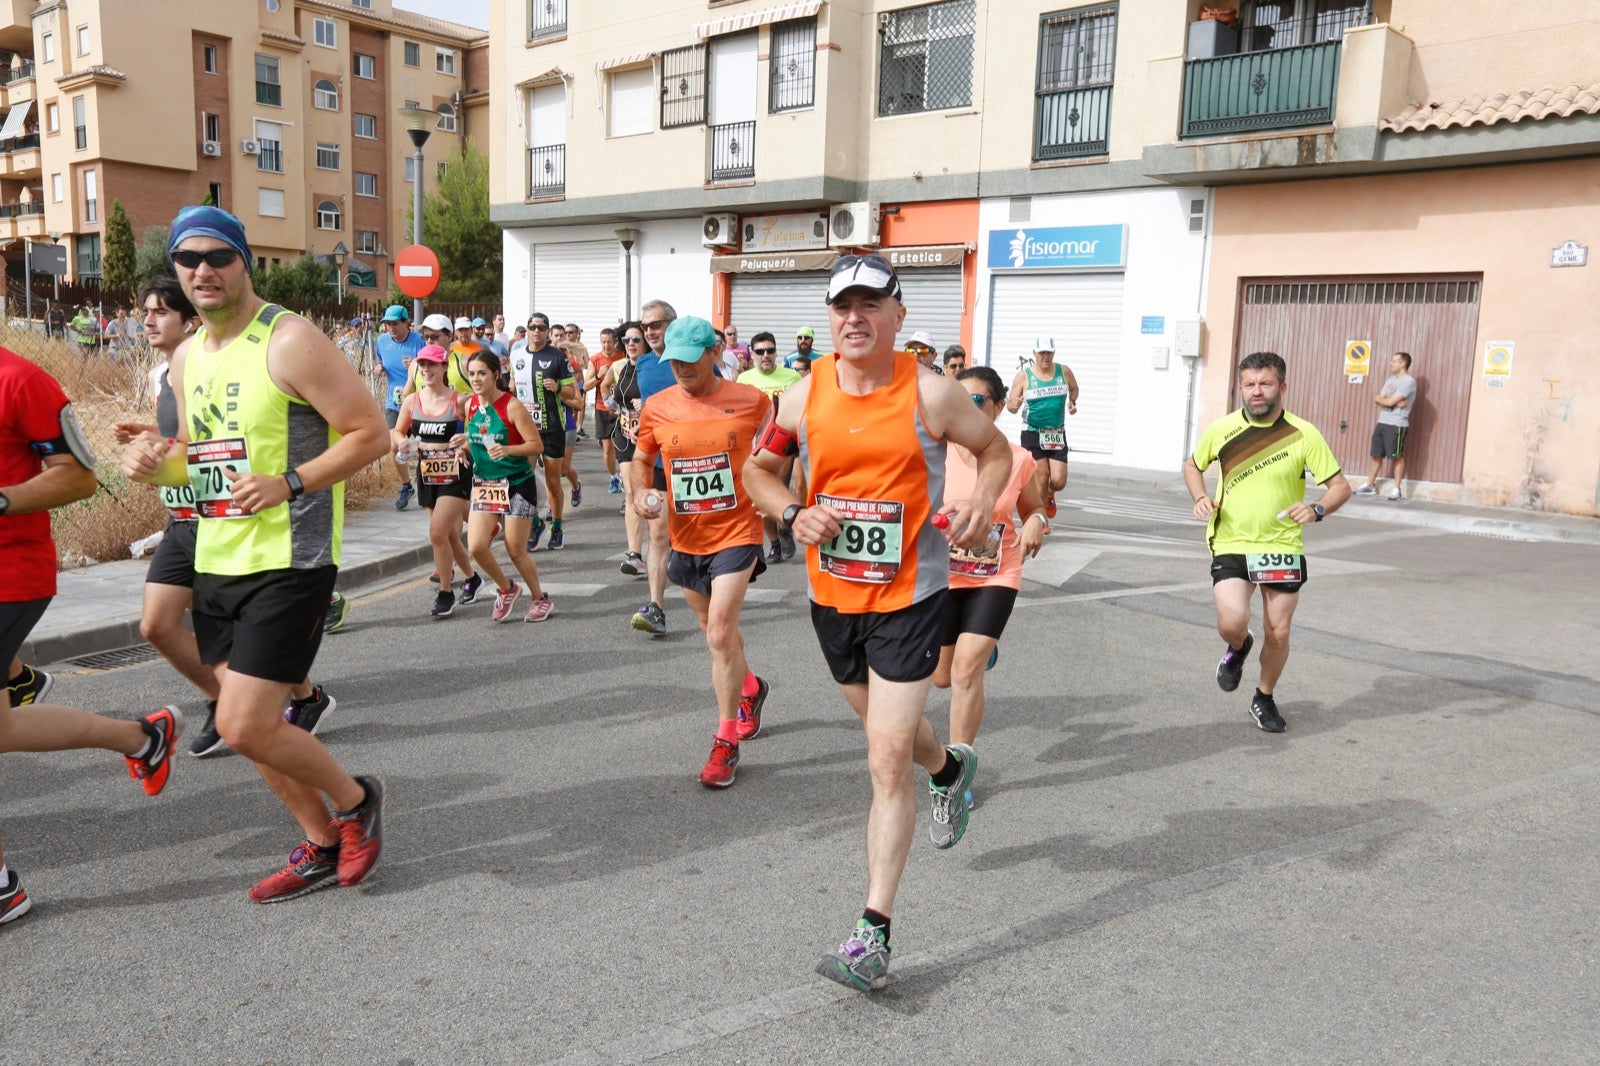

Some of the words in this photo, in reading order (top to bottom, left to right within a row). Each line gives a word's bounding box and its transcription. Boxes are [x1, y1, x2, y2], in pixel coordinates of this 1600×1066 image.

[1025, 237, 1099, 260] fisiomar
[418, 422, 447, 435] NIKE
[1044, 434, 1061, 442] 566
[425, 461, 456, 473] 2057
[681, 472, 724, 496] 704
[478, 489, 507, 501] 2178
[831, 500, 846, 510] GRAN
[846, 501, 868, 512] PREMIO
[868, 502, 877, 512] DE
[877, 503, 897, 514] FONDO
